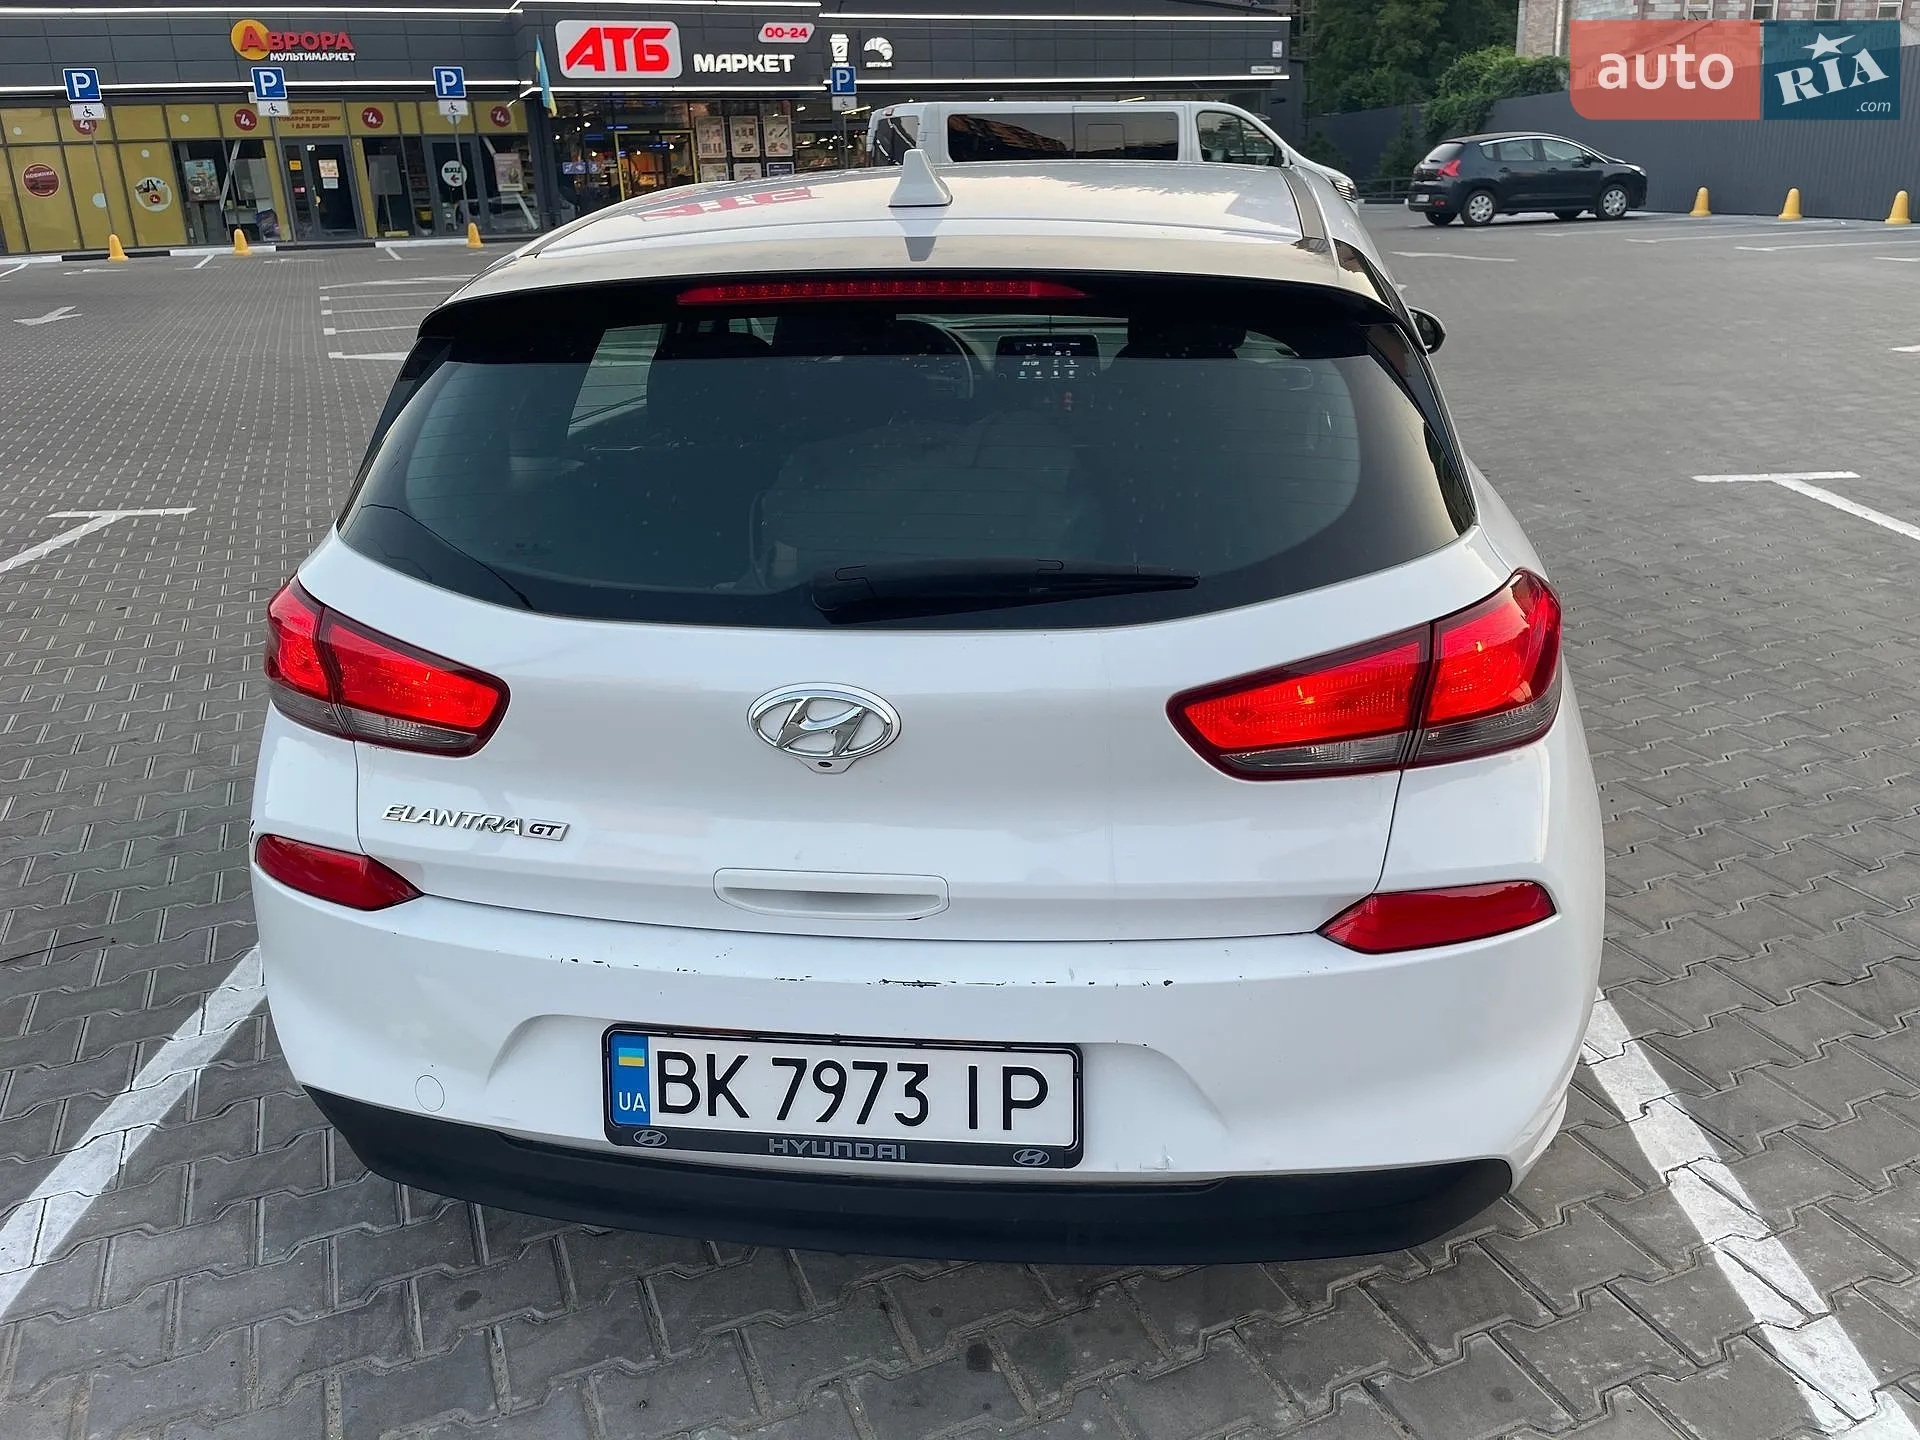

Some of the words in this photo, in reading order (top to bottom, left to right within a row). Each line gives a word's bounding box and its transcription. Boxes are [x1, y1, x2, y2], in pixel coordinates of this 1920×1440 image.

[240, 26, 354, 52] АВРОРА
[764, 27, 808, 39] 00-24
[270, 52, 356, 61] МУЛЬТИМАРКЕТ
[565, 27, 672, 72] АТБ
[693, 53, 796, 73] МАРКЕТ
[71, 72, 91, 98] P
[259, 71, 278, 96] P
[440, 70, 458, 95] P
[836, 69, 851, 91] P
[381, 803, 522, 836] ELANTRA
[528, 823, 563, 837] GT
[618, 1091, 647, 1112] UA
[656, 1050, 750, 1119] BK
[772, 1057, 929, 1127] 7973
[968, 1065, 1049, 1131] IP
[768, 1138, 906, 1160] HYUNDAI
